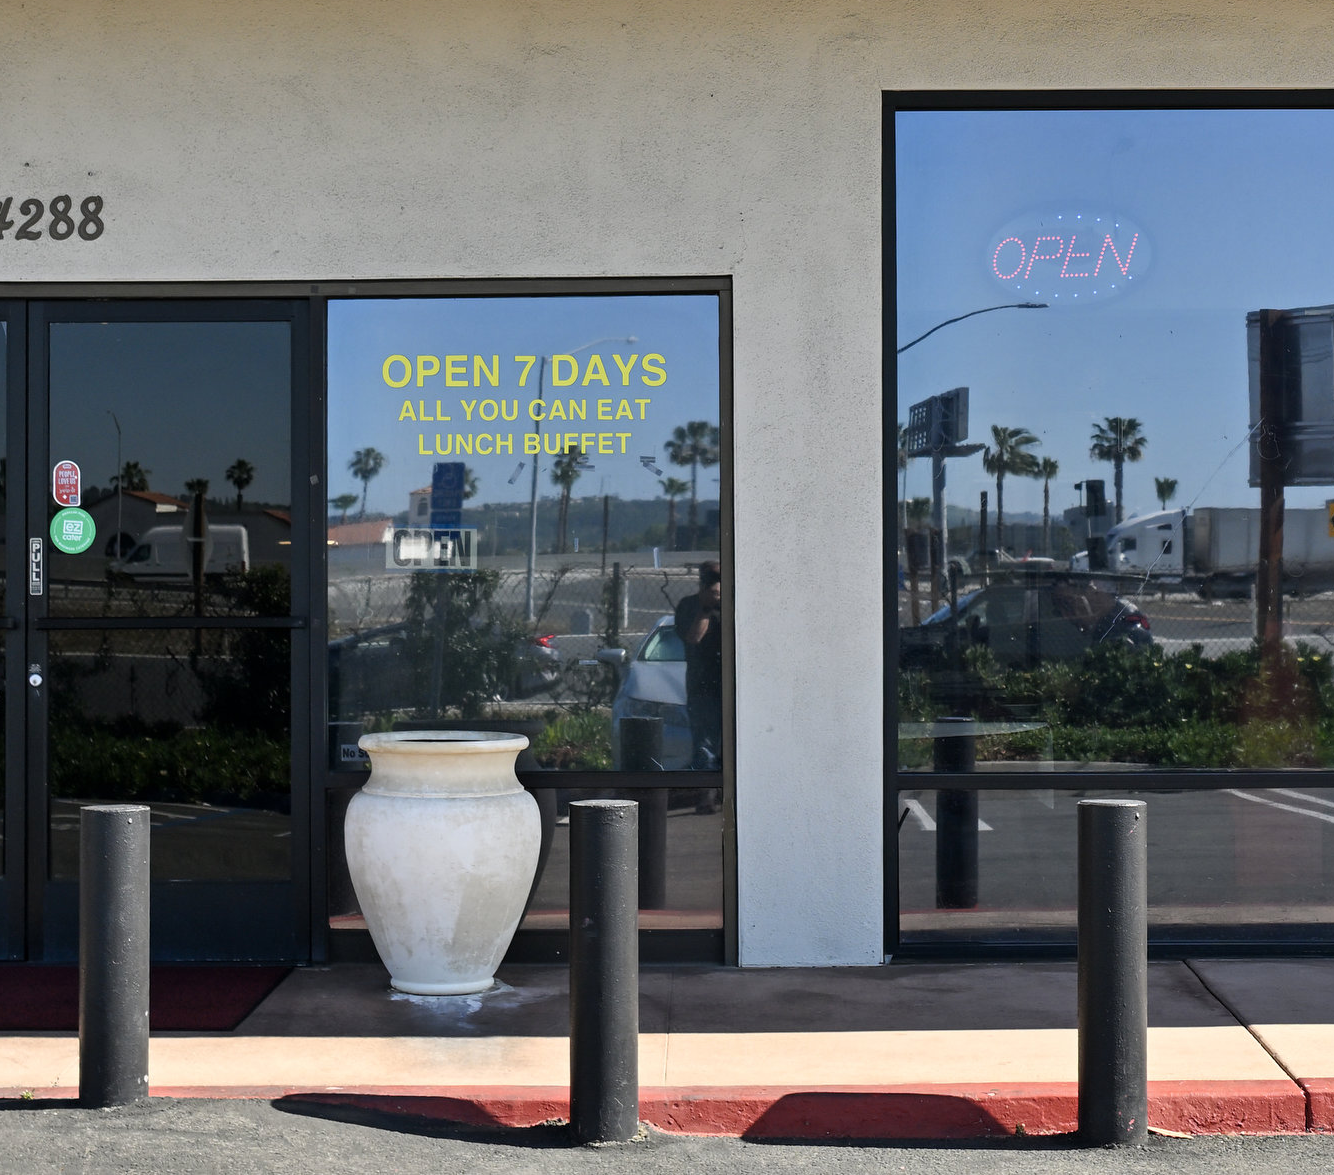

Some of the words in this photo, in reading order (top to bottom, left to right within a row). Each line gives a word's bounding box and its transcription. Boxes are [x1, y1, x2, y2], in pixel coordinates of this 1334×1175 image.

[992, 233, 1138, 279] OPEN
[382, 354, 499, 388] OPEN
[514, 355, 536, 387] 7
[552, 353, 668, 387] DAYS
[398, 400, 451, 422] ALL
[460, 399, 518, 422] YOU
[528, 399, 587, 421] CAN
[597, 398, 651, 420] EAT
[418, 433, 513, 456] LUNCH
[524, 432, 632, 455] BUFFET
[66, 523, 81, 532] ez
[32, 543, 41, 582] PULL
[393, 529, 471, 567] OPEN
[342, 747, 355, 758] No
